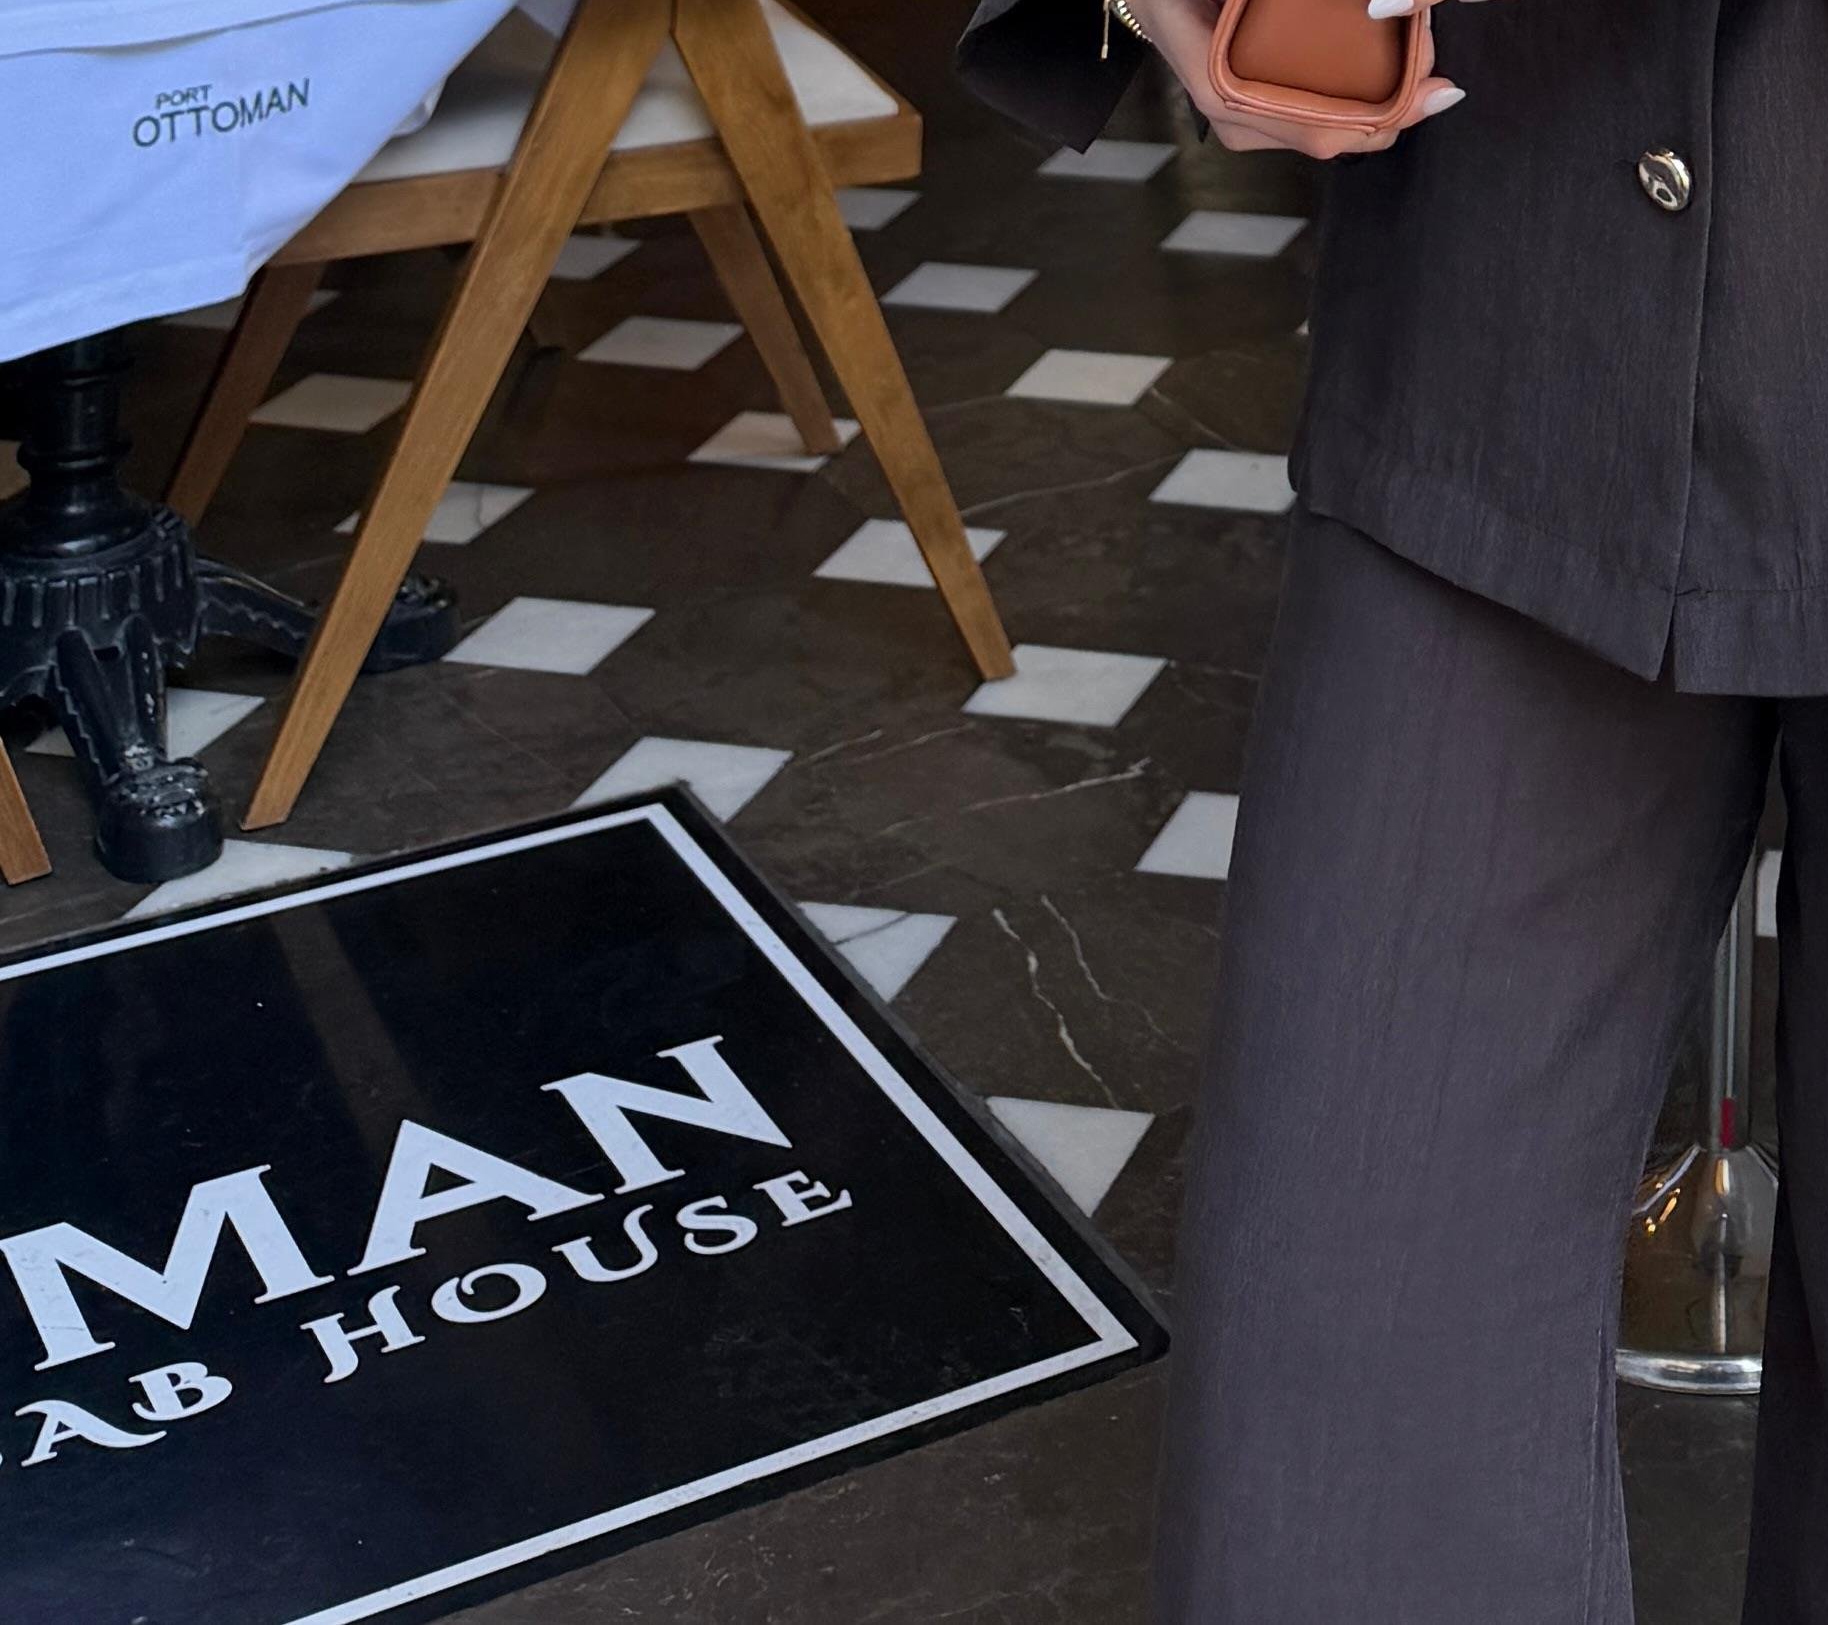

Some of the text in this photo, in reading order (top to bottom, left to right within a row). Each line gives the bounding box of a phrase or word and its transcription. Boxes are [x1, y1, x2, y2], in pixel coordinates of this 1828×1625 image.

[133, 77, 310, 148] OTTOMAN
[156, 83, 213, 110] PORT
[0, 1167, 854, 1469] AB HOUSE
